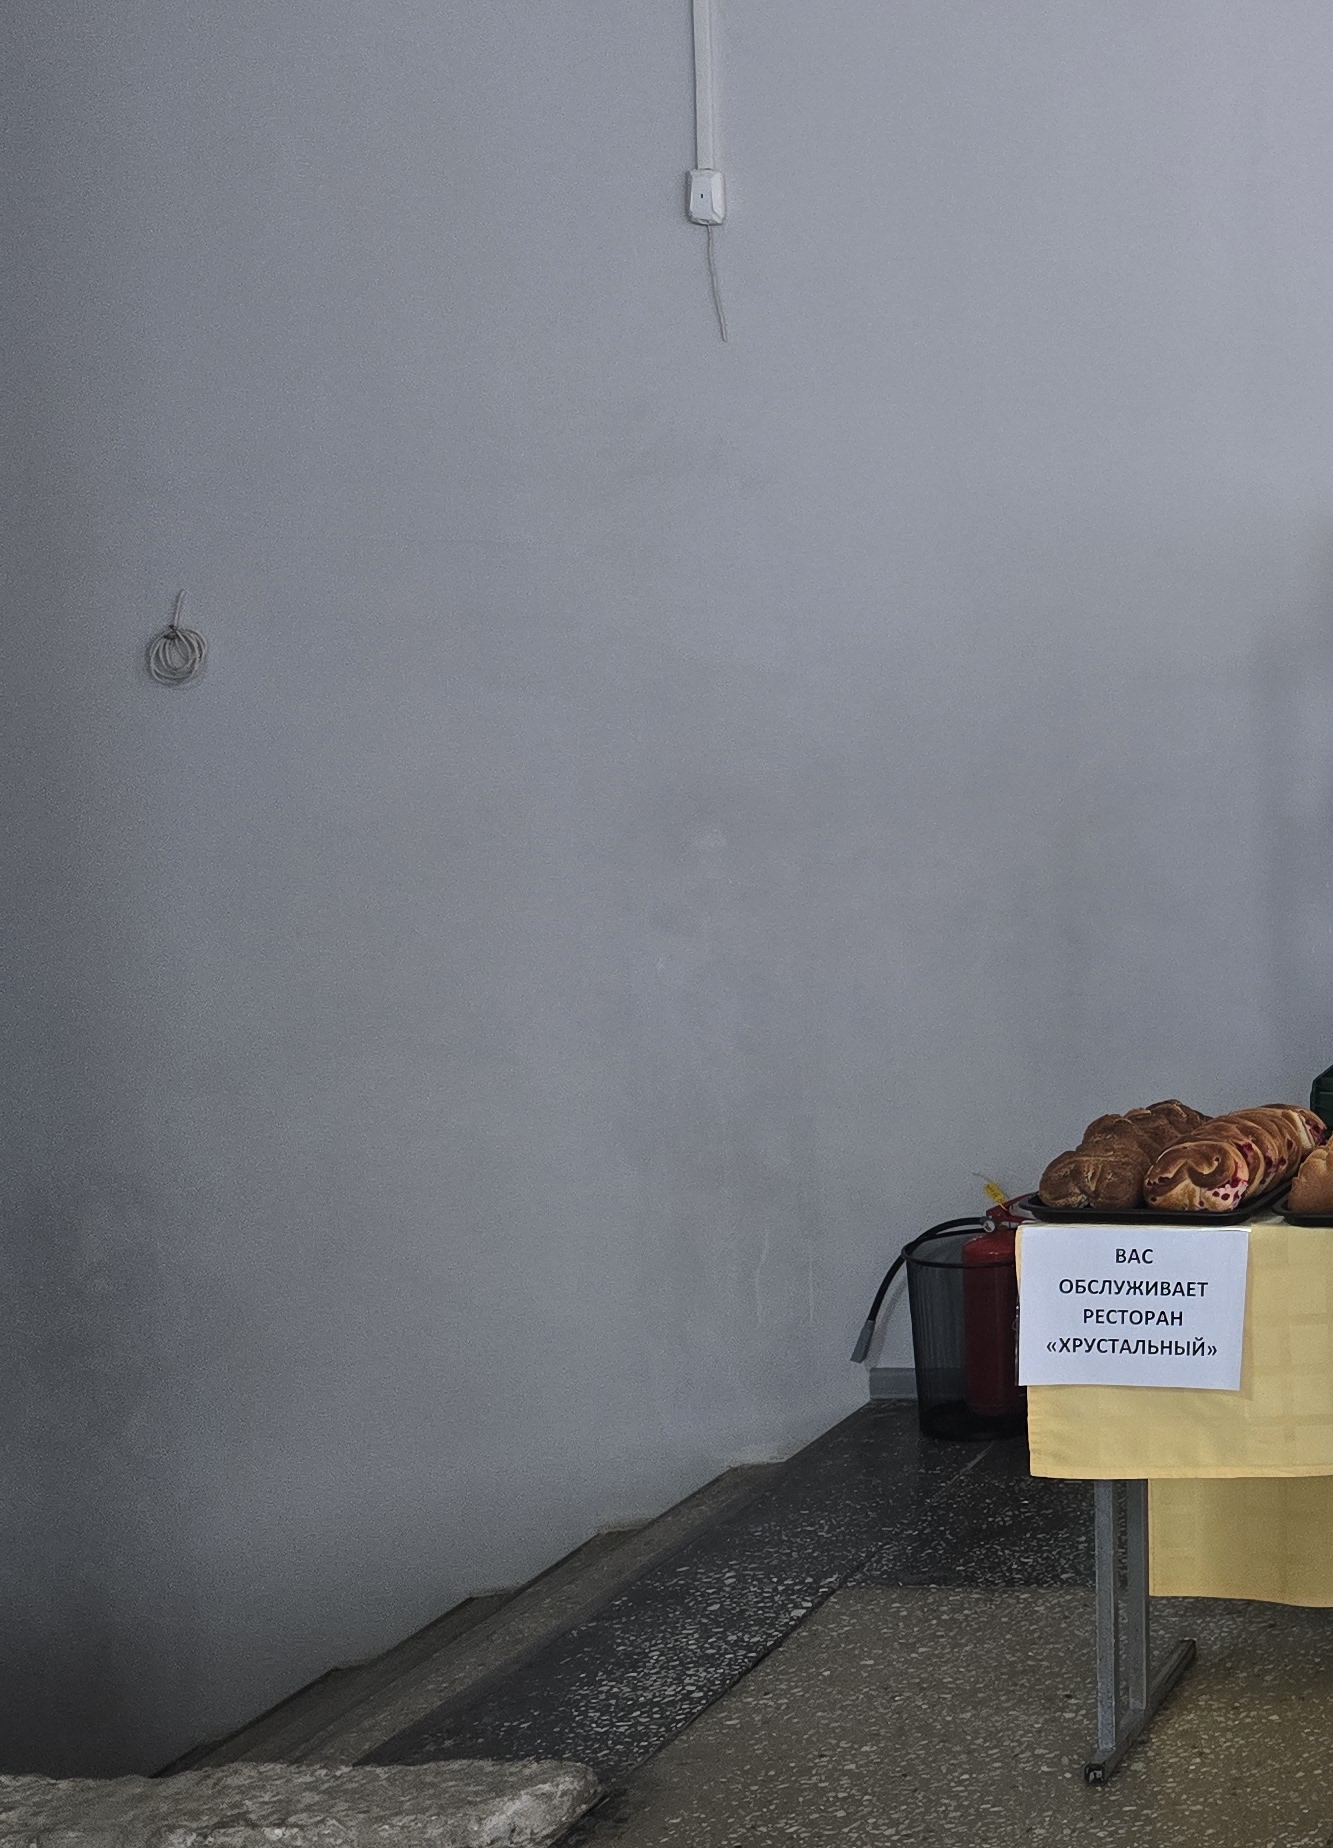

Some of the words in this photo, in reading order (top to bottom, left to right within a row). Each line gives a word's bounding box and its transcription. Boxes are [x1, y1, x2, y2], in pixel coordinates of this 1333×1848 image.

[1115, 1249, 1154, 1264] ВАС
[1058, 1278, 1209, 1297] ОБСЛУЖИВАЕТ
[1083, 1308, 1183, 1326] РЕСТОРАН
[1046, 1336, 1218, 1357] «ХРУСТАЛЬНЫЙ»
